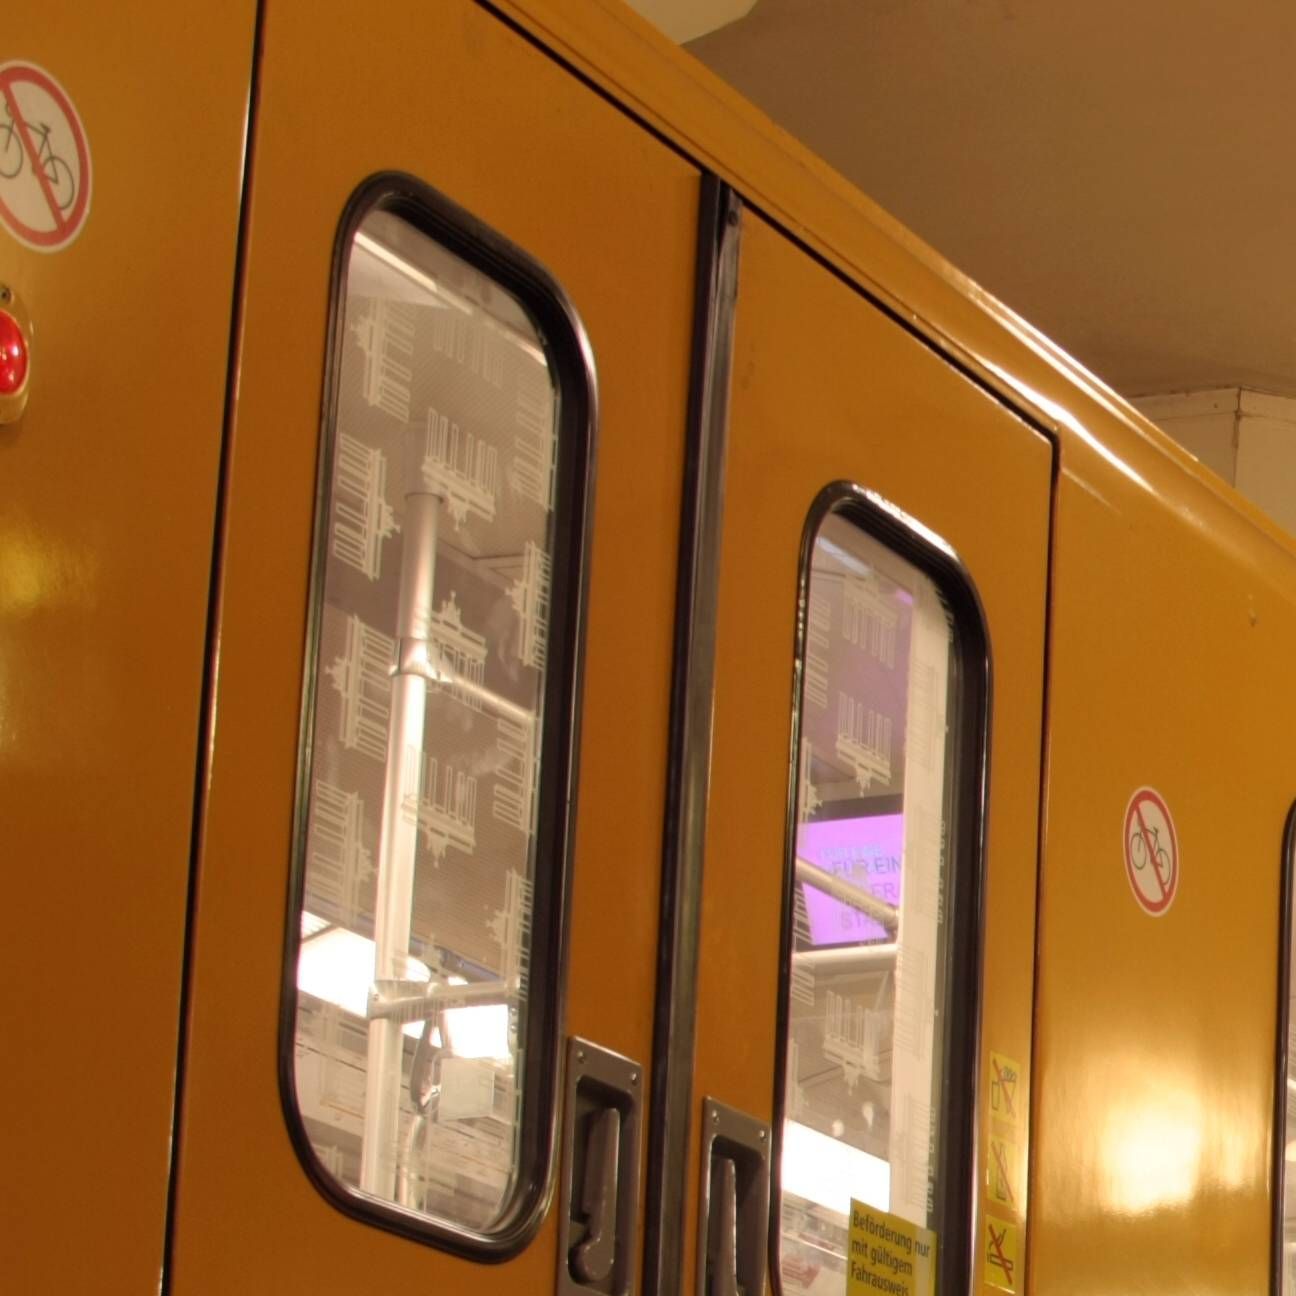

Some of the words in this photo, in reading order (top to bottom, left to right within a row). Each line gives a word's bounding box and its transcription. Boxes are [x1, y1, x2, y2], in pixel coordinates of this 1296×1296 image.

[852, 1209, 912, 1256] Beförderung
[914, 1239, 930, 1258] nur
[851, 1237, 868, 1258] mit
[870, 1244, 913, 1276] gültigem
